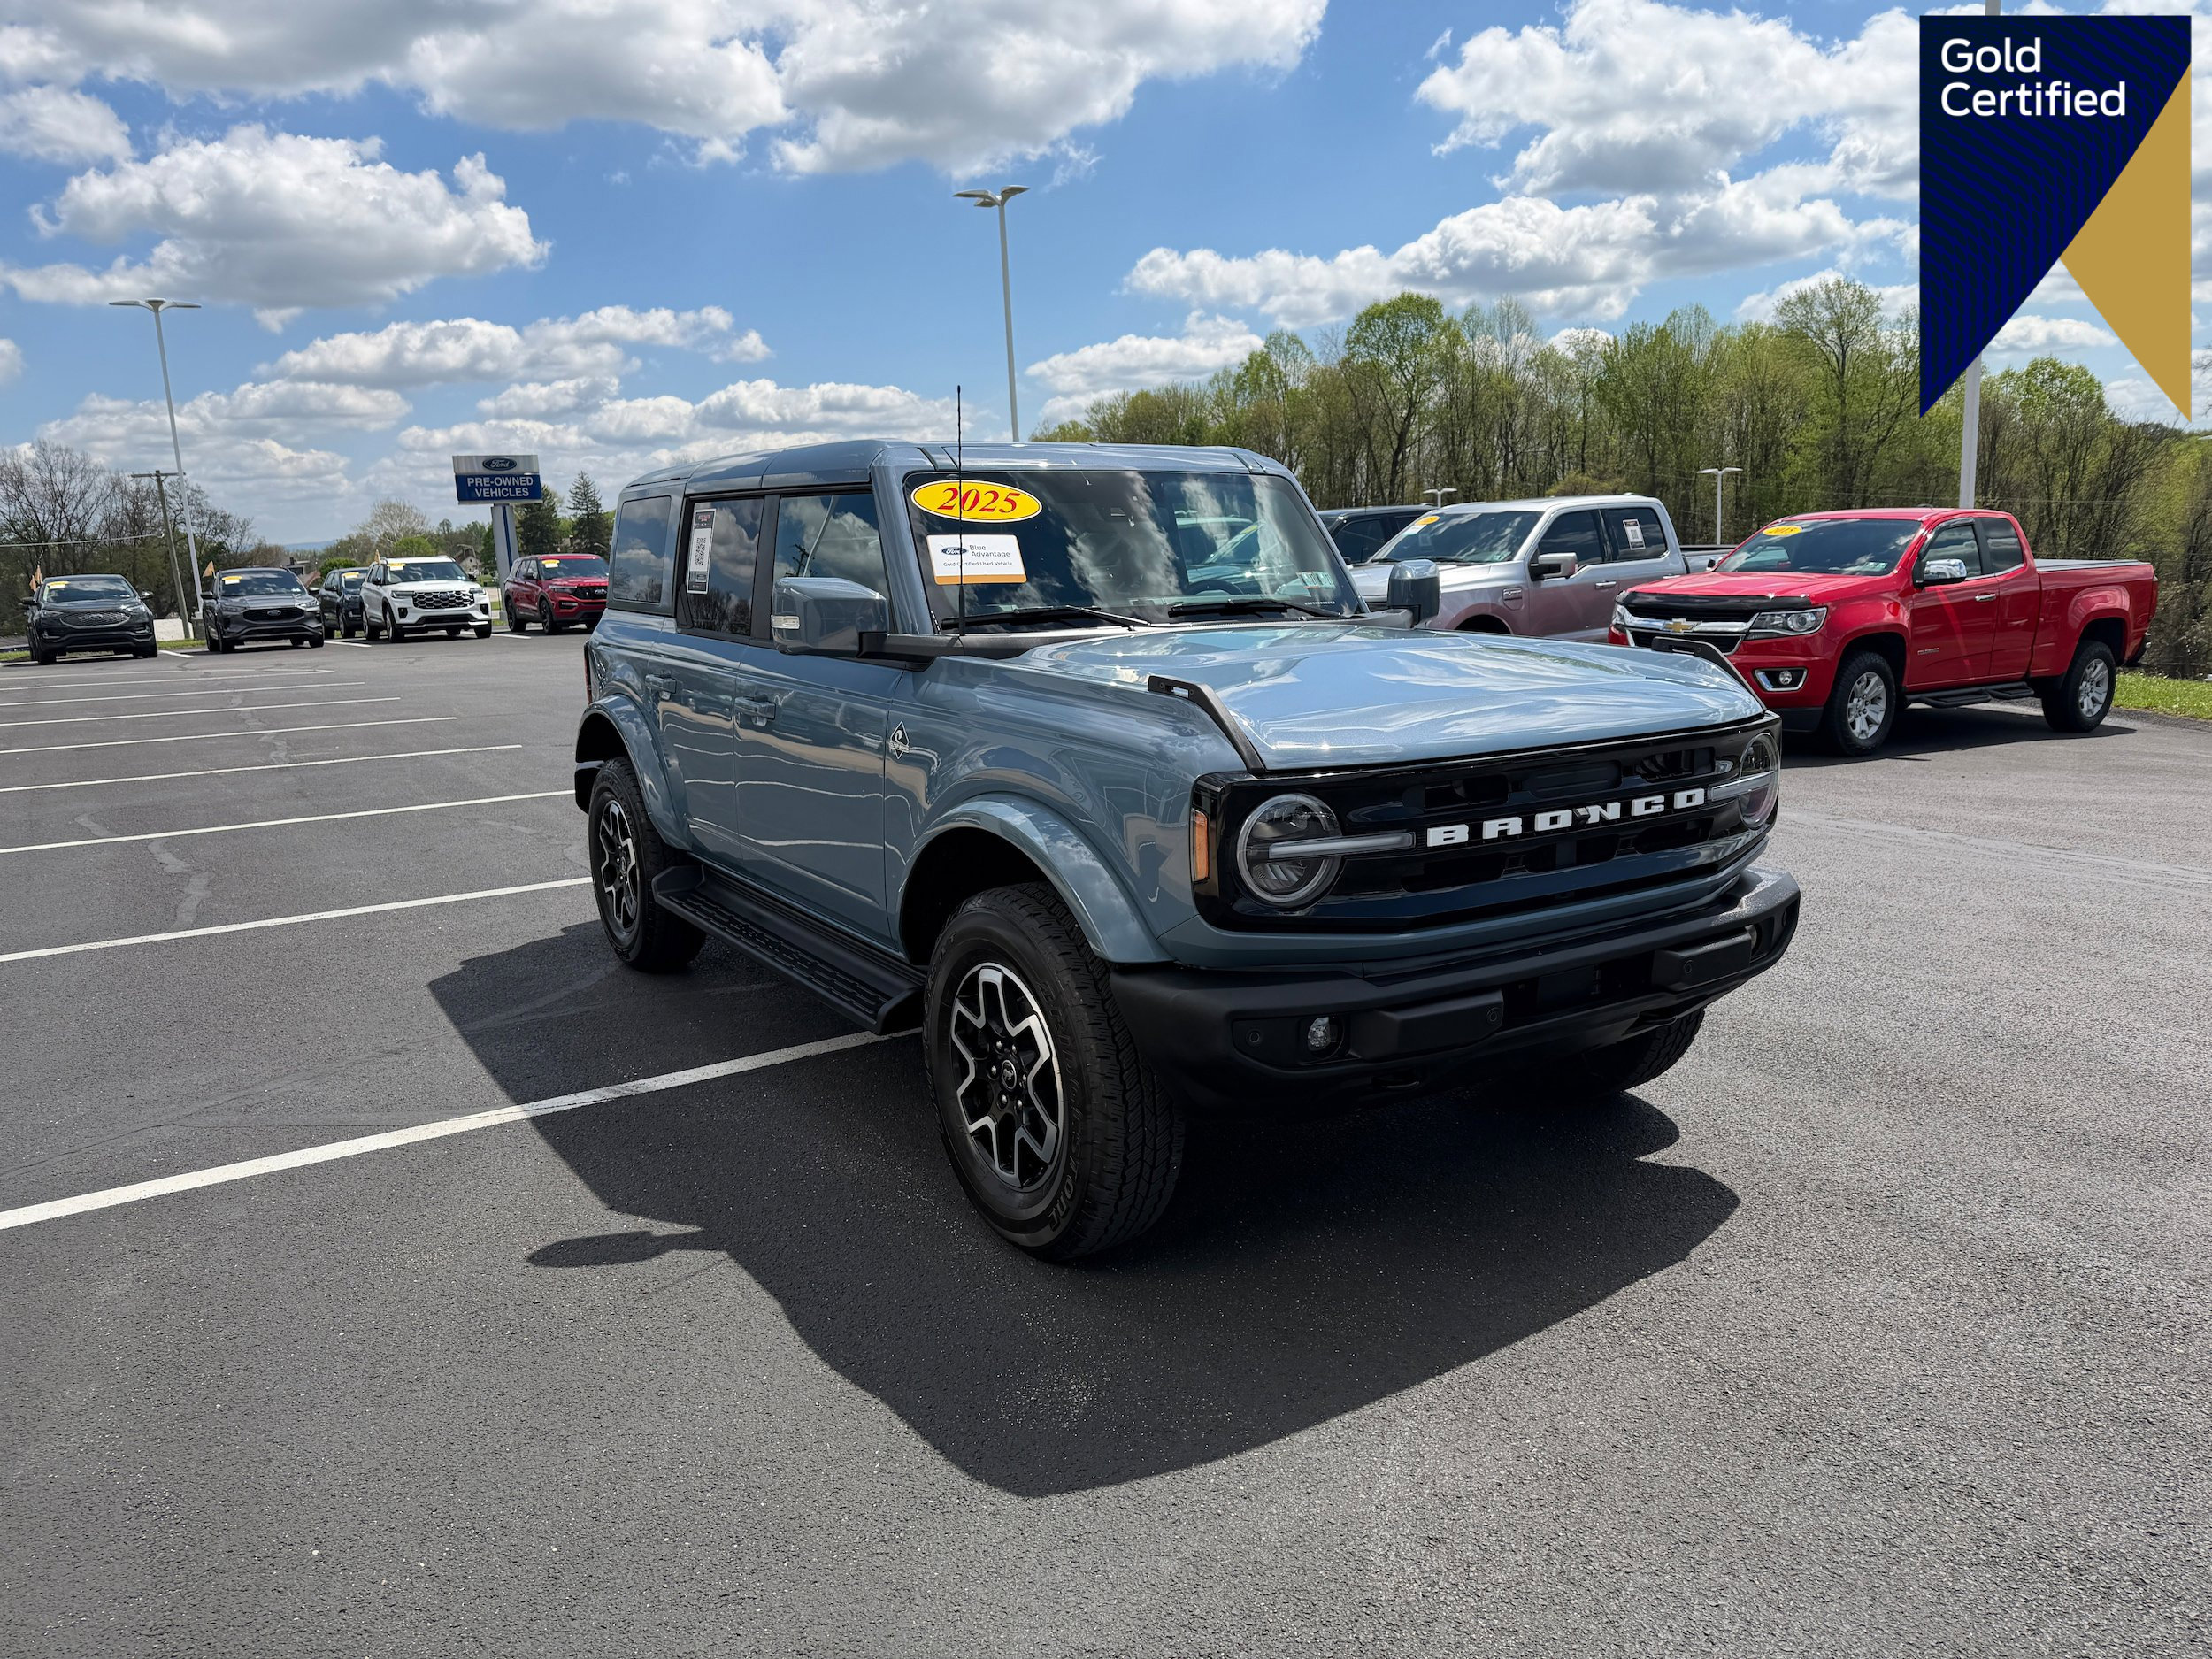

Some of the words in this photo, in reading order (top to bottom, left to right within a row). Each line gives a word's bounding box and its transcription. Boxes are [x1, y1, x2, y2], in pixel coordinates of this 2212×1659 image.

[490, 459, 510, 469] Ford
[467, 477, 534, 487] PRE-OWNED
[475, 488, 529, 497] VEHICLES
[937, 488, 1021, 513] 2025
[1427, 787, 1706, 848] BRONCO
